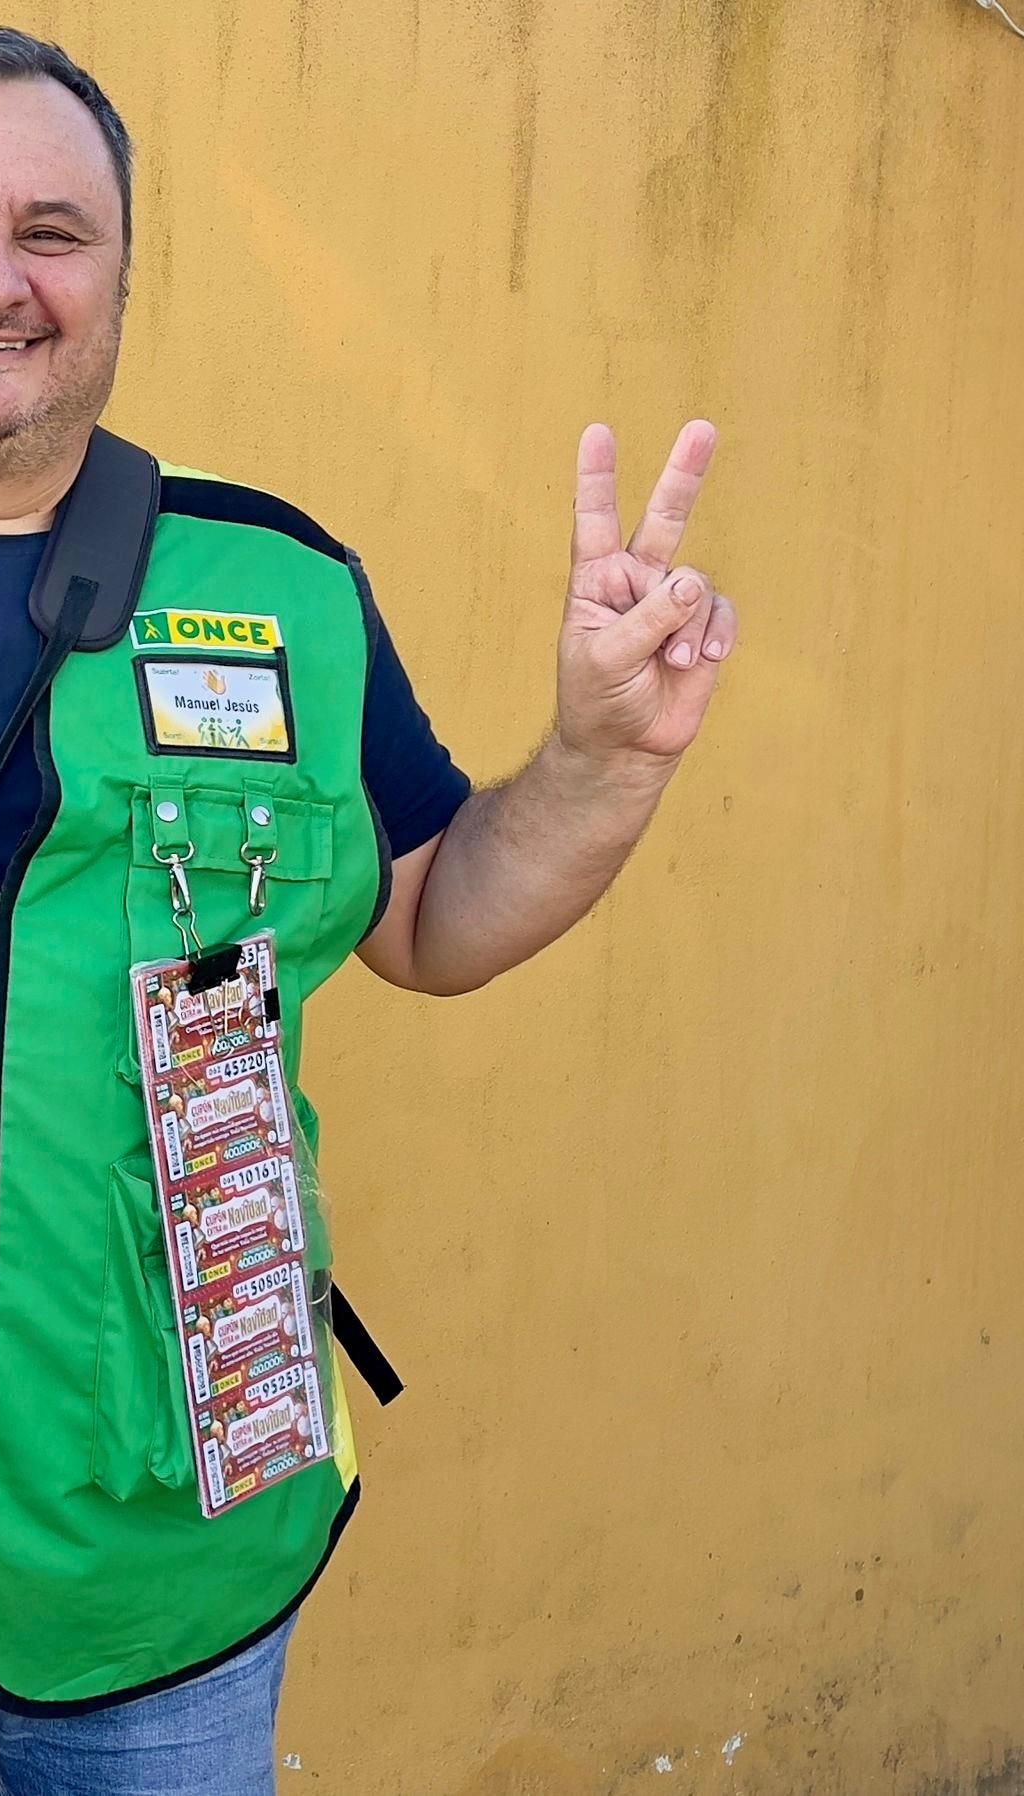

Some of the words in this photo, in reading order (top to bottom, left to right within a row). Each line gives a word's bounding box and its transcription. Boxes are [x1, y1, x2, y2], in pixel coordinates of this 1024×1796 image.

[177, 617, 269, 645] ONCE
[175, 695, 220, 711] Manuel
[225, 700, 260, 714] Jesús
[182, 1050, 201, 1060] ONCE
[224, 1052, 263, 1078] 45220
[213, 1087, 252, 1117] Navidad
[194, 1154, 214, 1168] ONCE
[239, 1161, 278, 1187] 10161
[228, 1195, 267, 1227] Navidad
[209, 1264, 229, 1278] ONCE
[250, 1267, 288, 1296] 50802
[239, 1302, 278, 1337] Navidad
[220, 1374, 239, 1390] ONCE
[262, 1367, 301, 1398] 95253
[253, 1403, 290, 1439] Navidad
[234, 1477, 253, 1493] ONCE
